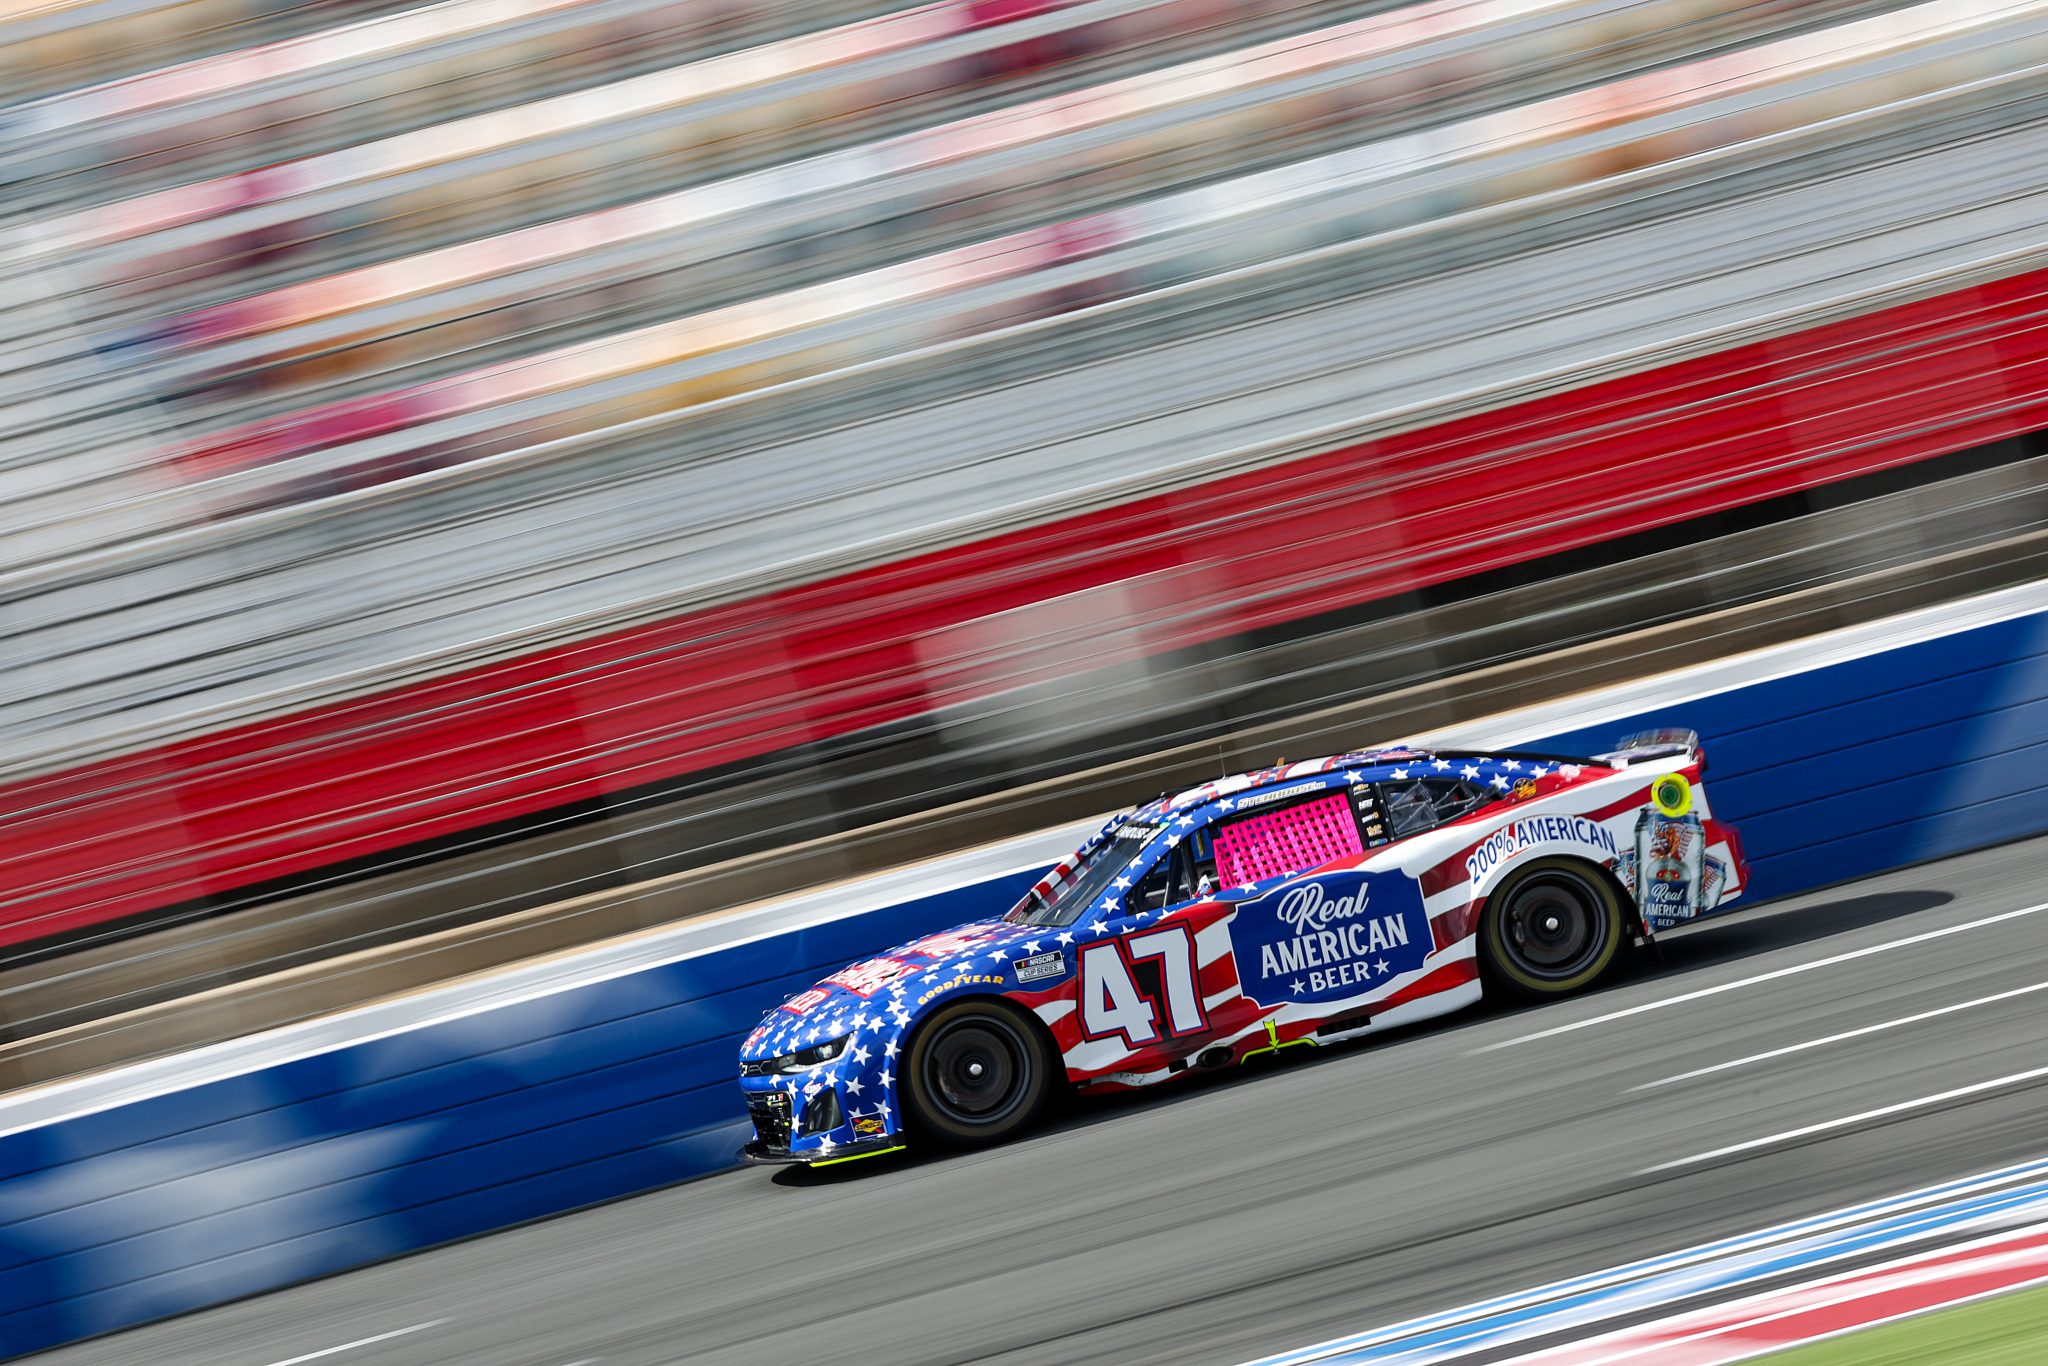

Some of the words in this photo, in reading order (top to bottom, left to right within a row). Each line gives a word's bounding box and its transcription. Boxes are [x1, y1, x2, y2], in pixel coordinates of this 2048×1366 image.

[1469, 826, 1513, 884] 200%
[1517, 816, 1617, 854] AMERICAN
[1651, 883, 1683, 902] Real
[1276, 882, 1370, 936] Real
[1645, 903, 1690, 918] AMERICAN
[1029, 954, 1055, 966] NASCAR
[1261, 913, 1410, 980] AMERICAN
[1023, 967, 1036, 978] CUP
[1036, 963, 1058, 975] SERIES
[1078, 921, 1209, 1047] 47
[1309, 961, 1371, 993] BEER
[917, 974, 1004, 1005] GOODYEAR
[854, 1119, 883, 1132] SUNOCO
